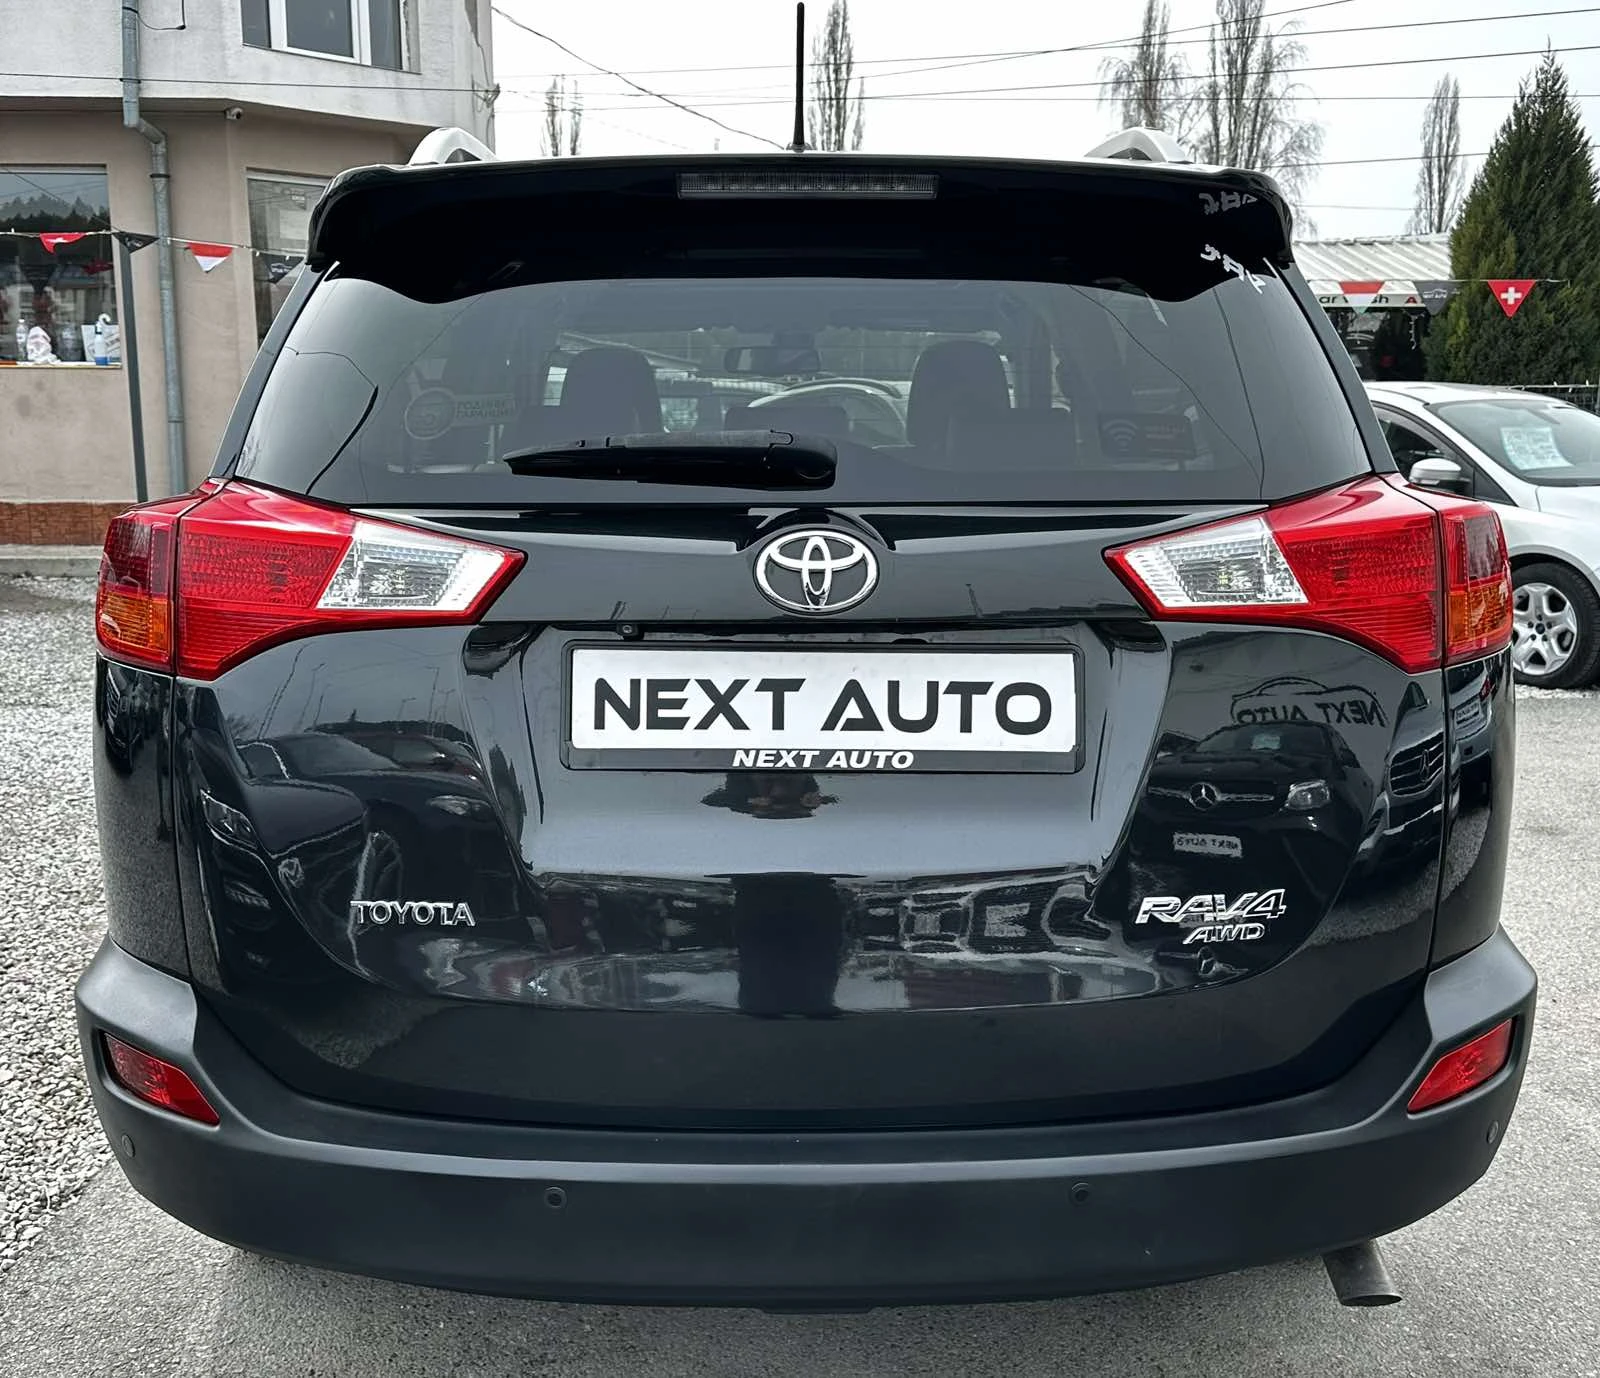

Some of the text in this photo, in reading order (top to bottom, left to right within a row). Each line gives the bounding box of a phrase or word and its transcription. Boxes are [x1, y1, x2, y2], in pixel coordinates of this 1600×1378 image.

[1319, 295, 1336, 304] ar
[593, 677, 1052, 735] NEXT AUTO
[732, 749, 915, 769] NEXT AUTO
[350, 900, 476, 927] TOYOTA
[1135, 888, 1287, 924] RAV4
[1182, 922, 1265, 945] AWD
